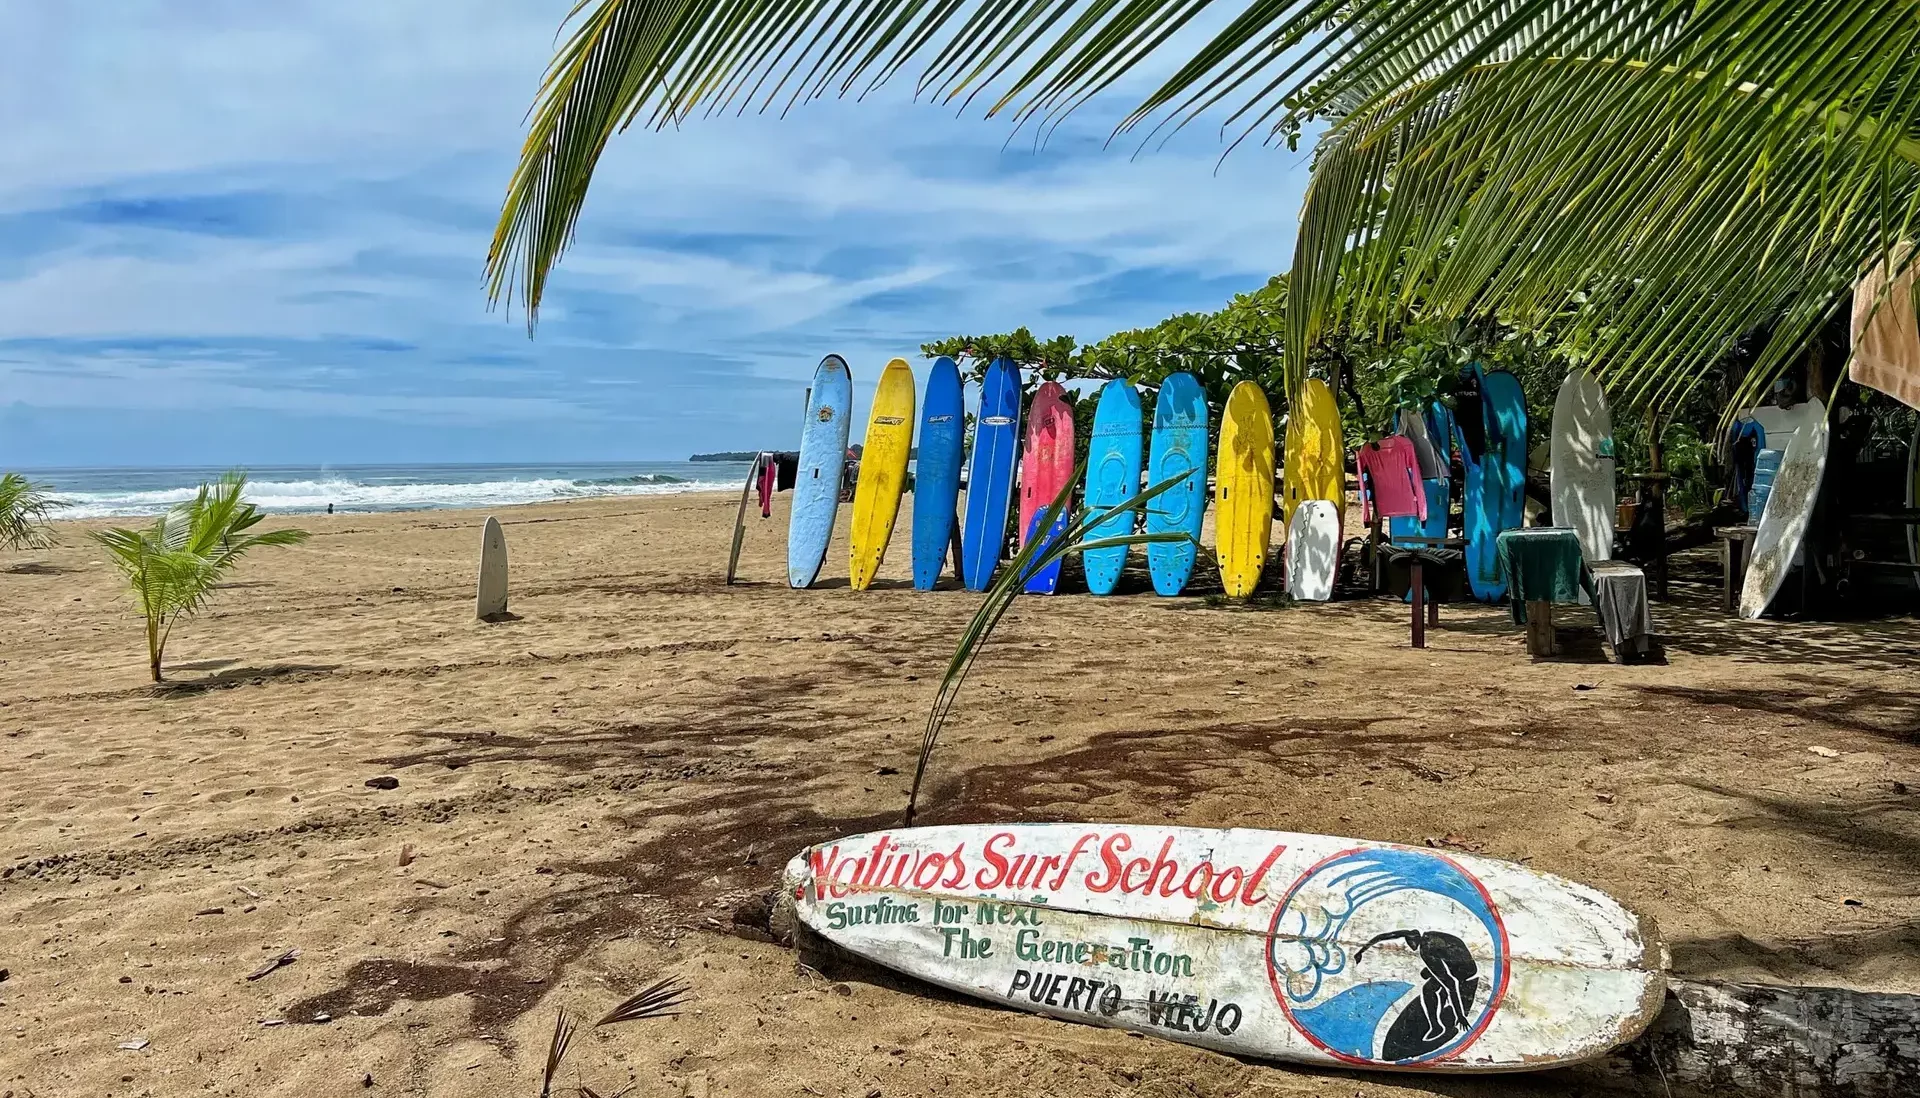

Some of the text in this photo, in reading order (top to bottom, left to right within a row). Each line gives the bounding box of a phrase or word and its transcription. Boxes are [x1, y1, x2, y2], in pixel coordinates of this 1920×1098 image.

[809, 832, 1288, 906] Nativos Surf School
[976, 893, 1049, 927] Next
[941, 927, 994, 960] The
[1006, 969, 1242, 1036] PUERTO VIEJO
